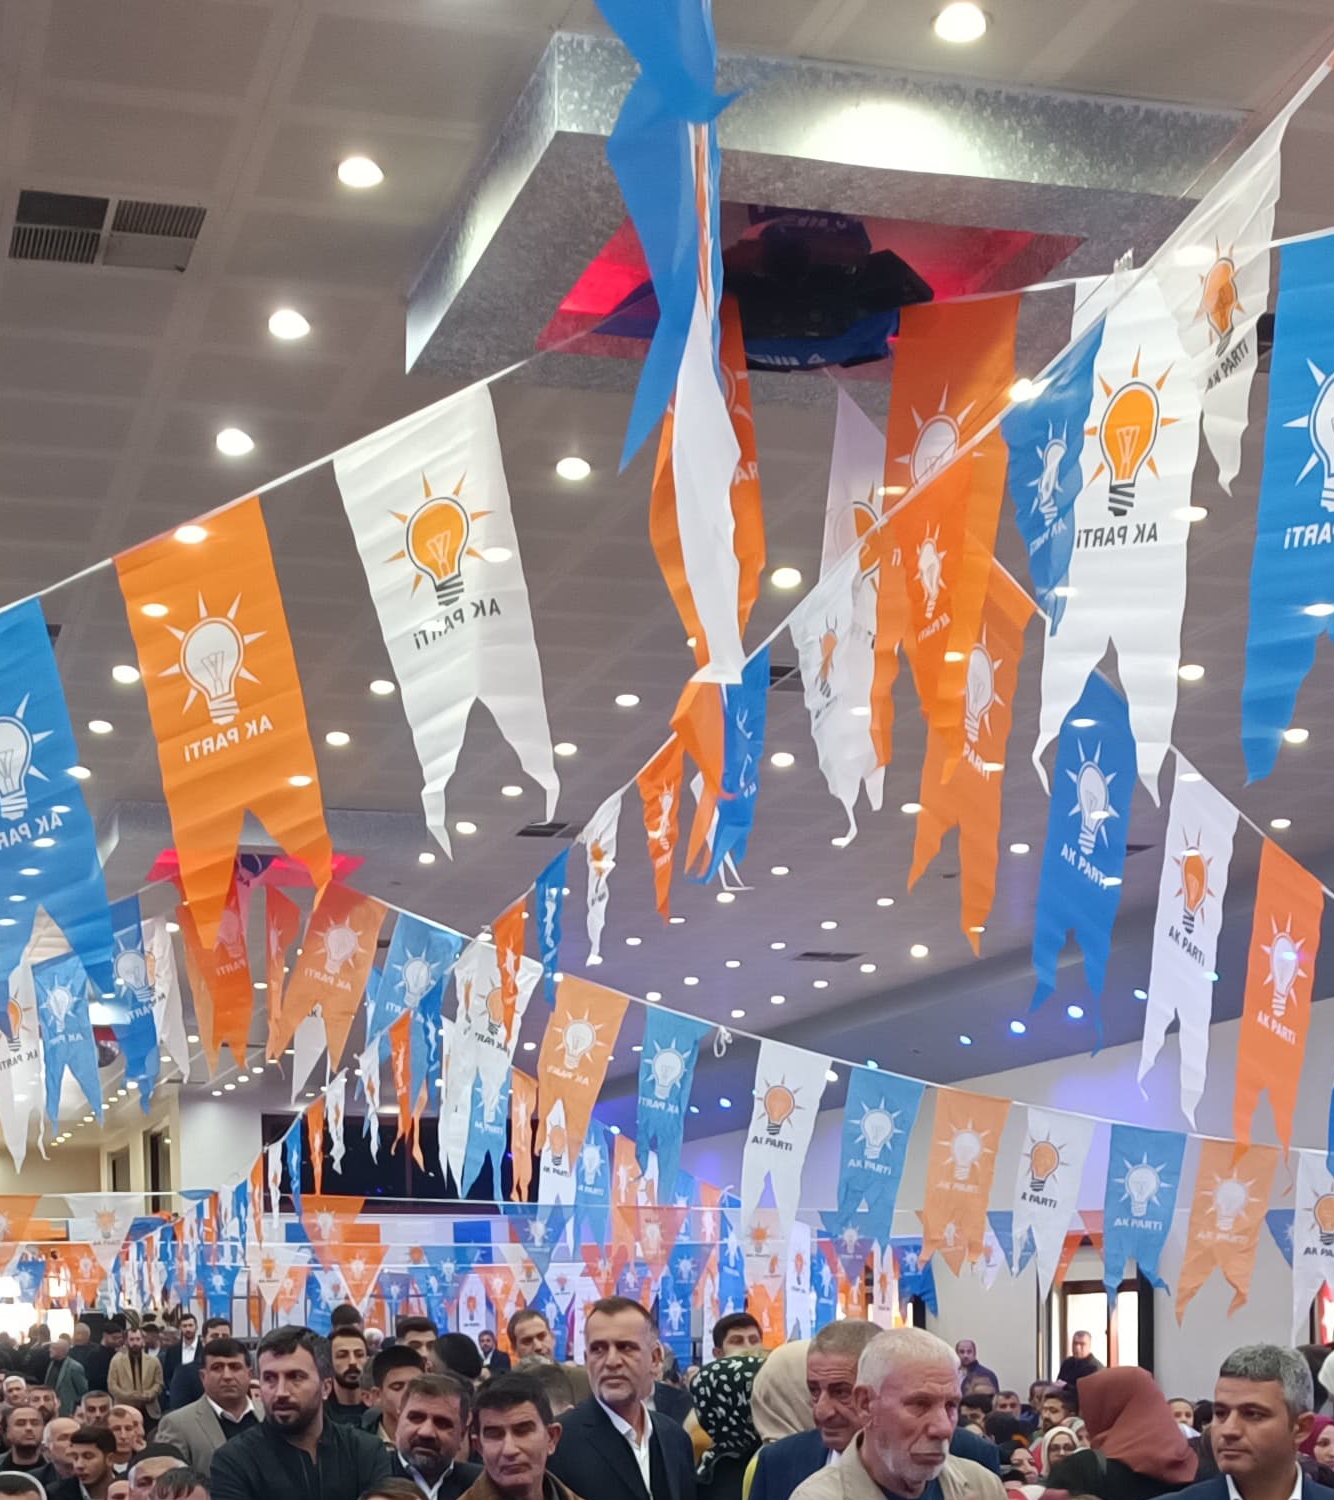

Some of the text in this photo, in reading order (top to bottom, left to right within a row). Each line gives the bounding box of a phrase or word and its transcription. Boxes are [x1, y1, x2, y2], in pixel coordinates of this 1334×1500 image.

[1060, 843, 1076, 866] AK
[1168, 925, 1180, 944] AK
[1257, 1010, 1270, 1030] AK
[1114, 1217, 1129, 1227] AK
[1303, 1246, 1318, 1256] AK
